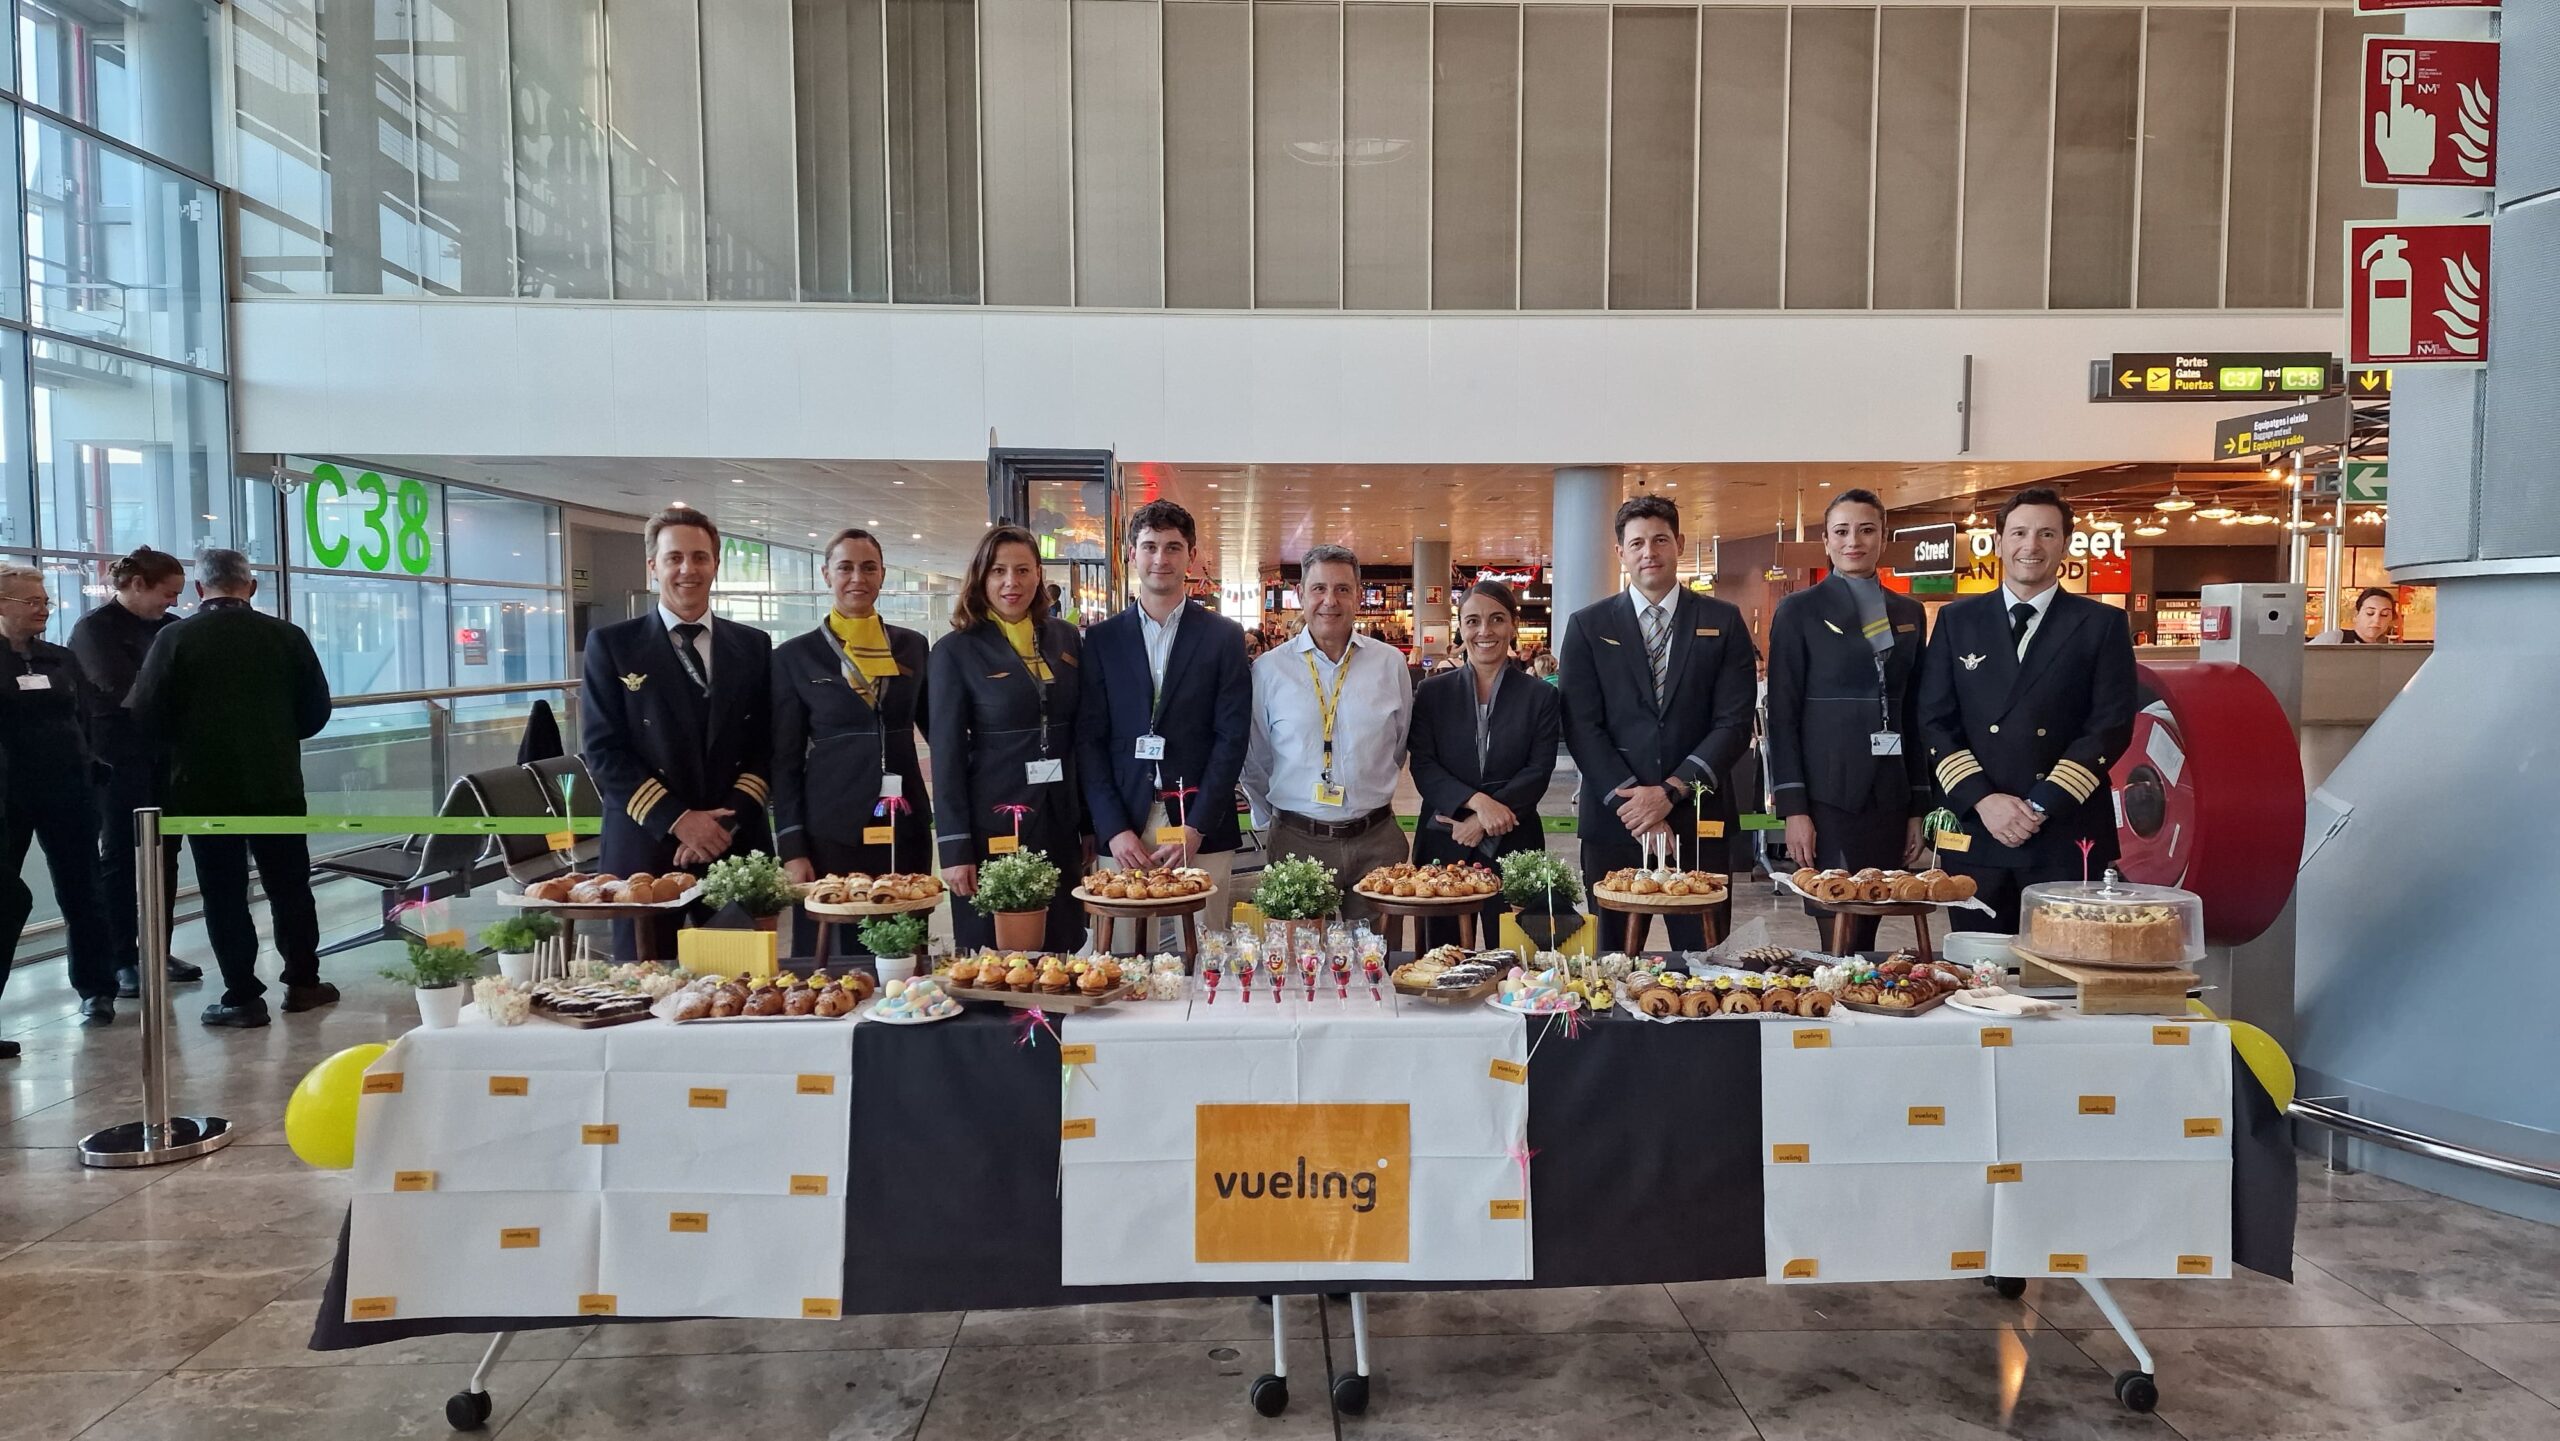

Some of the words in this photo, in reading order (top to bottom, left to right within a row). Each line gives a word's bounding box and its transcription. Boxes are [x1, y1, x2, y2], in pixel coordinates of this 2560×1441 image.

[2176, 357, 2208, 368] Portes
[2176, 369, 2200, 379] Gates
[2223, 371, 2257, 387] C37
[2264, 368, 2281, 378] and
[2286, 371, 2320, 387] C38
[2175, 379, 2214, 390] Puertas
[2268, 382, 2275, 391] y
[305, 463, 431, 575] C38
[1149, 747, 1161, 756] 27
[1214, 1156, 1377, 1213] vueling
